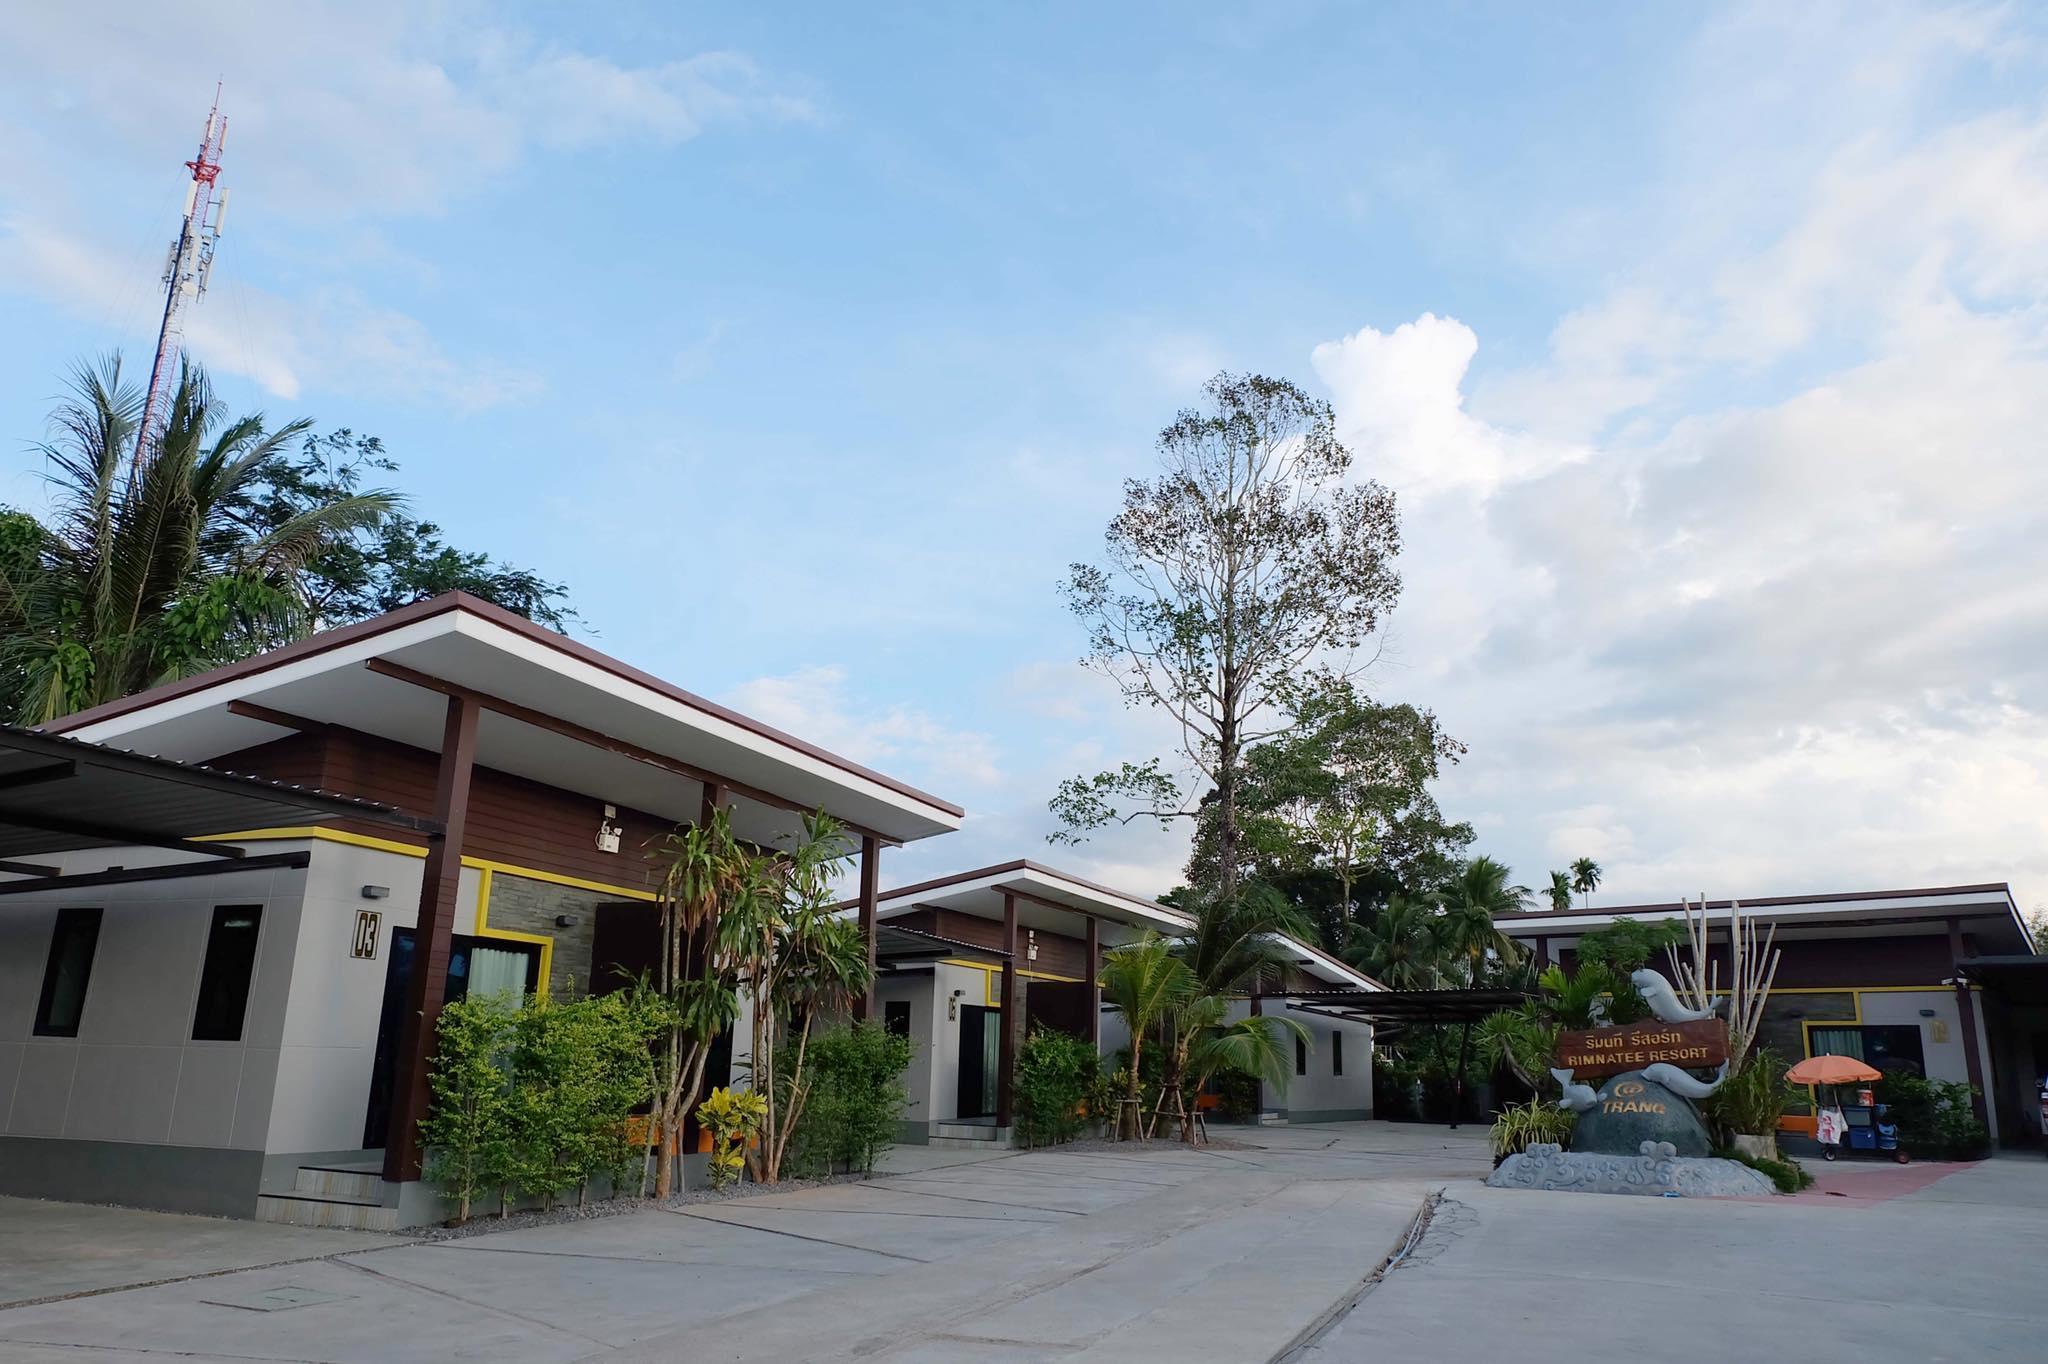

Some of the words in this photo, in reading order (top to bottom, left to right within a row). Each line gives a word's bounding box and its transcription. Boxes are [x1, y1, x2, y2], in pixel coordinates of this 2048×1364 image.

[355, 912, 378, 957] 03
[1568, 1052, 1645, 1066] RIMNATEE
[1649, 1047, 1709, 1062] RESORT
